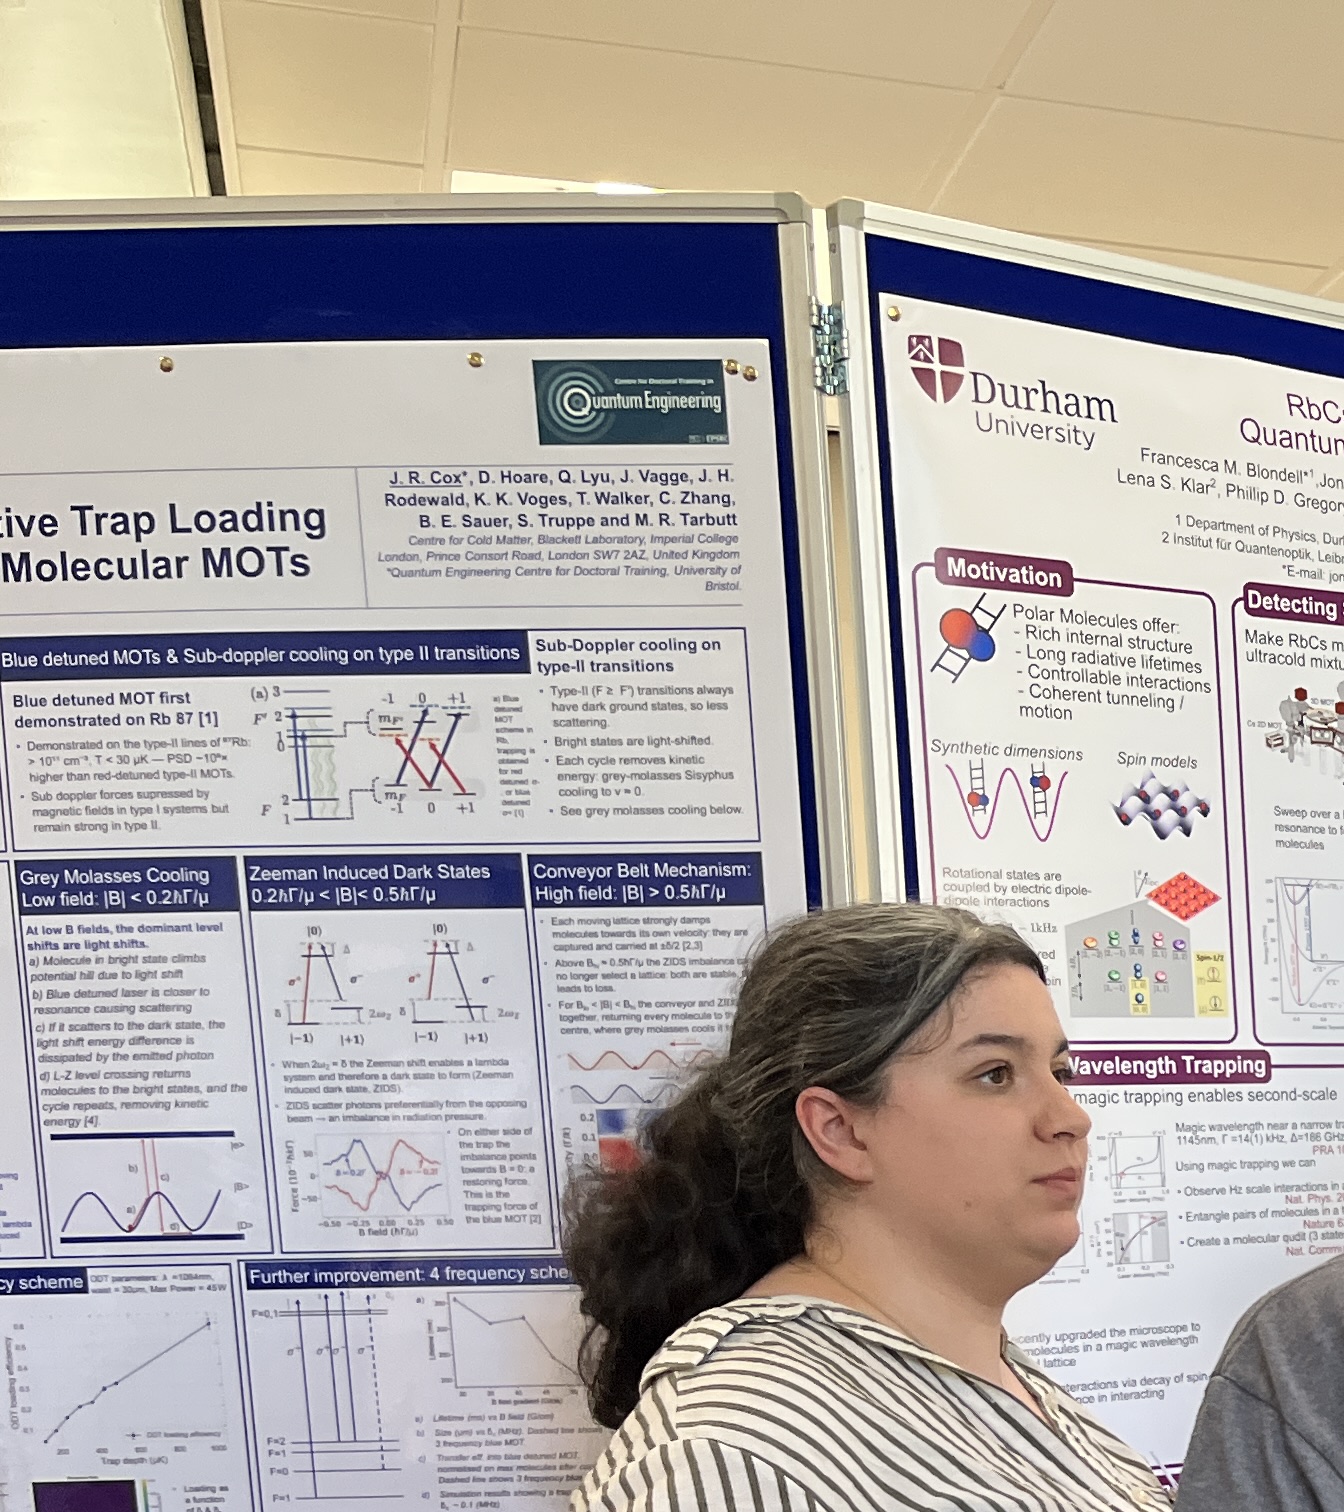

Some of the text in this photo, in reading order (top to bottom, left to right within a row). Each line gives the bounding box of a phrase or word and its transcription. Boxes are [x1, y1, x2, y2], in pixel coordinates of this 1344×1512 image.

[563, 387, 721, 415] Quantum Engineering
[969, 371, 1118, 423] Durham
[975, 410, 1095, 450] University
[69, 504, 155, 542] Trap
[168, 501, 325, 539] Loading
[1, 546, 310, 582] Molecular MOTs
[946, 556, 1061, 587] Motivation
[1247, 589, 1337, 621] Detecting
[1012, 603, 1179, 633] Polar Molecules offer:
[535, 637, 720, 654] Sub-Doppler cooling on
[1244, 628, 1283, 646] Make
[1288, 633, 1327, 650] RbCs
[1, 645, 519, 667] Blue detuned MOTs & Sub-doppler cooling on type II transitions
[1026, 643, 1202, 673] Long radiative lifetimes
[1245, 647, 1305, 666] ultracold
[536, 659, 674, 676] type-II transitions
[554, 735, 712, 749] Bright states are light-shifted.
[930, 738, 1083, 761] Synthetic dimensions
[1116, 751, 1197, 769] Spin models
[19, 867, 209, 888] Grey Molasses Cooling
[249, 863, 490, 880] Zeeman Induced Dark States
[533, 861, 751, 881] Conveyor Belt Mechanism:
[1181, 1055, 1265, 1077] Trapping
[1074, 1086, 1337, 1108] magic trapping enables second-scale
[1175, 1161, 1204, 1173] Using
[1207, 1161, 1237, 1171] magic
[1239, 1159, 1279, 1170] trapping
[1298, 1159, 1316, 1167] can
[249, 1265, 573, 1285] Further improvement: 4 frequency sche
